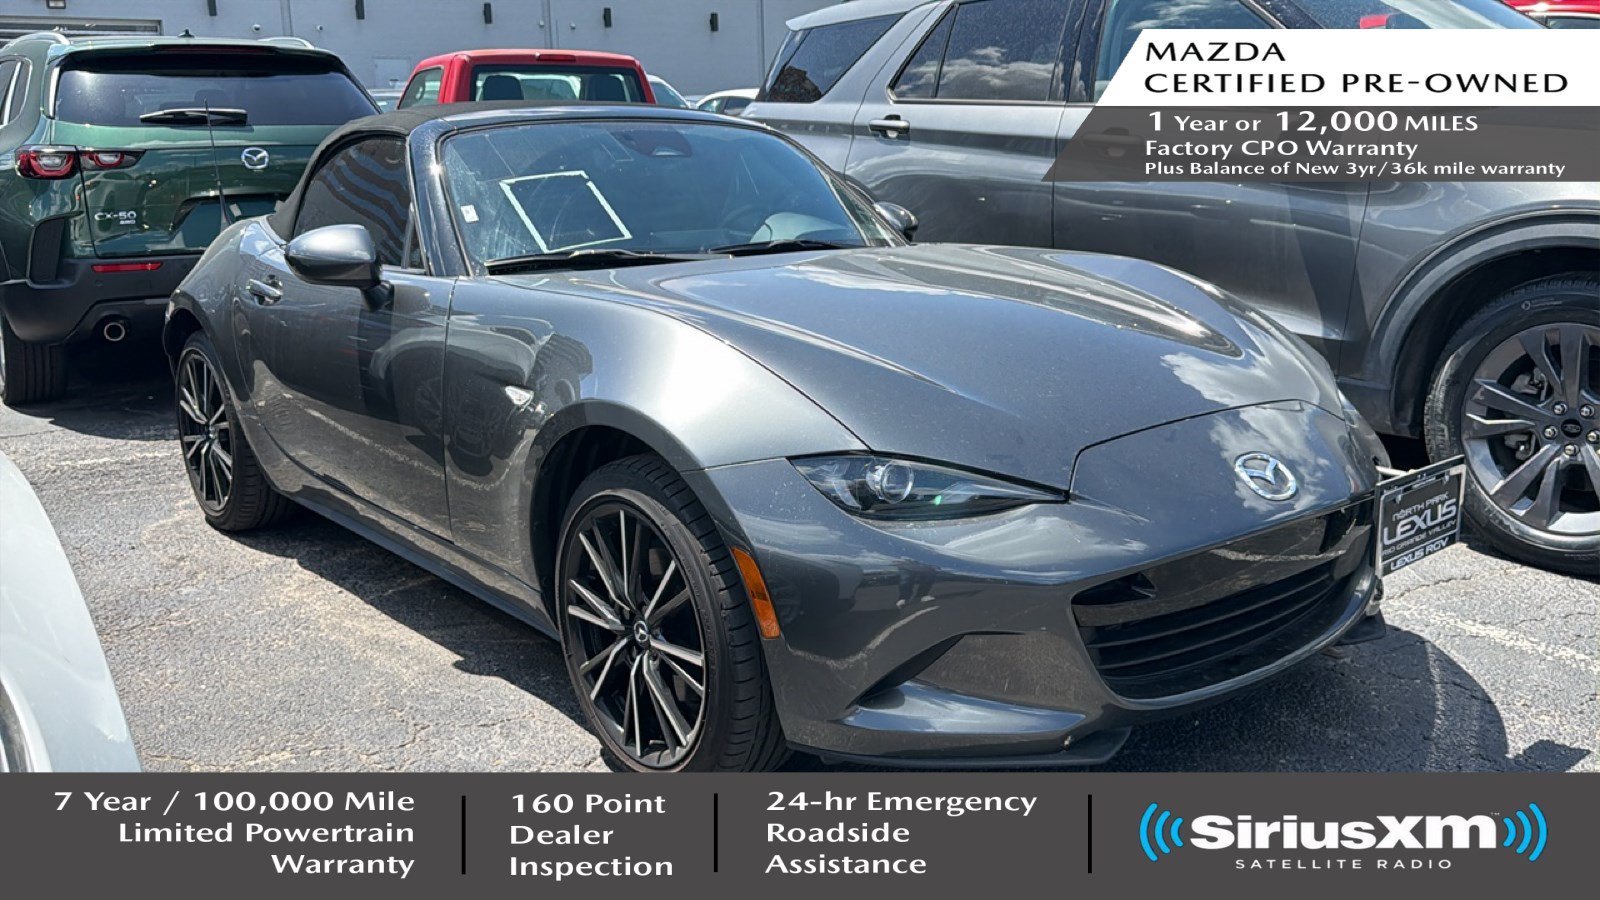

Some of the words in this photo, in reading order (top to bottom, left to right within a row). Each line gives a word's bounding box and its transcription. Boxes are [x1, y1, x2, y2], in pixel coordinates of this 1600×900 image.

[94, 210, 137, 221] CX-50
[1383, 498, 1457, 546] LEXUS
[1390, 548, 1425, 571] LEXUS
